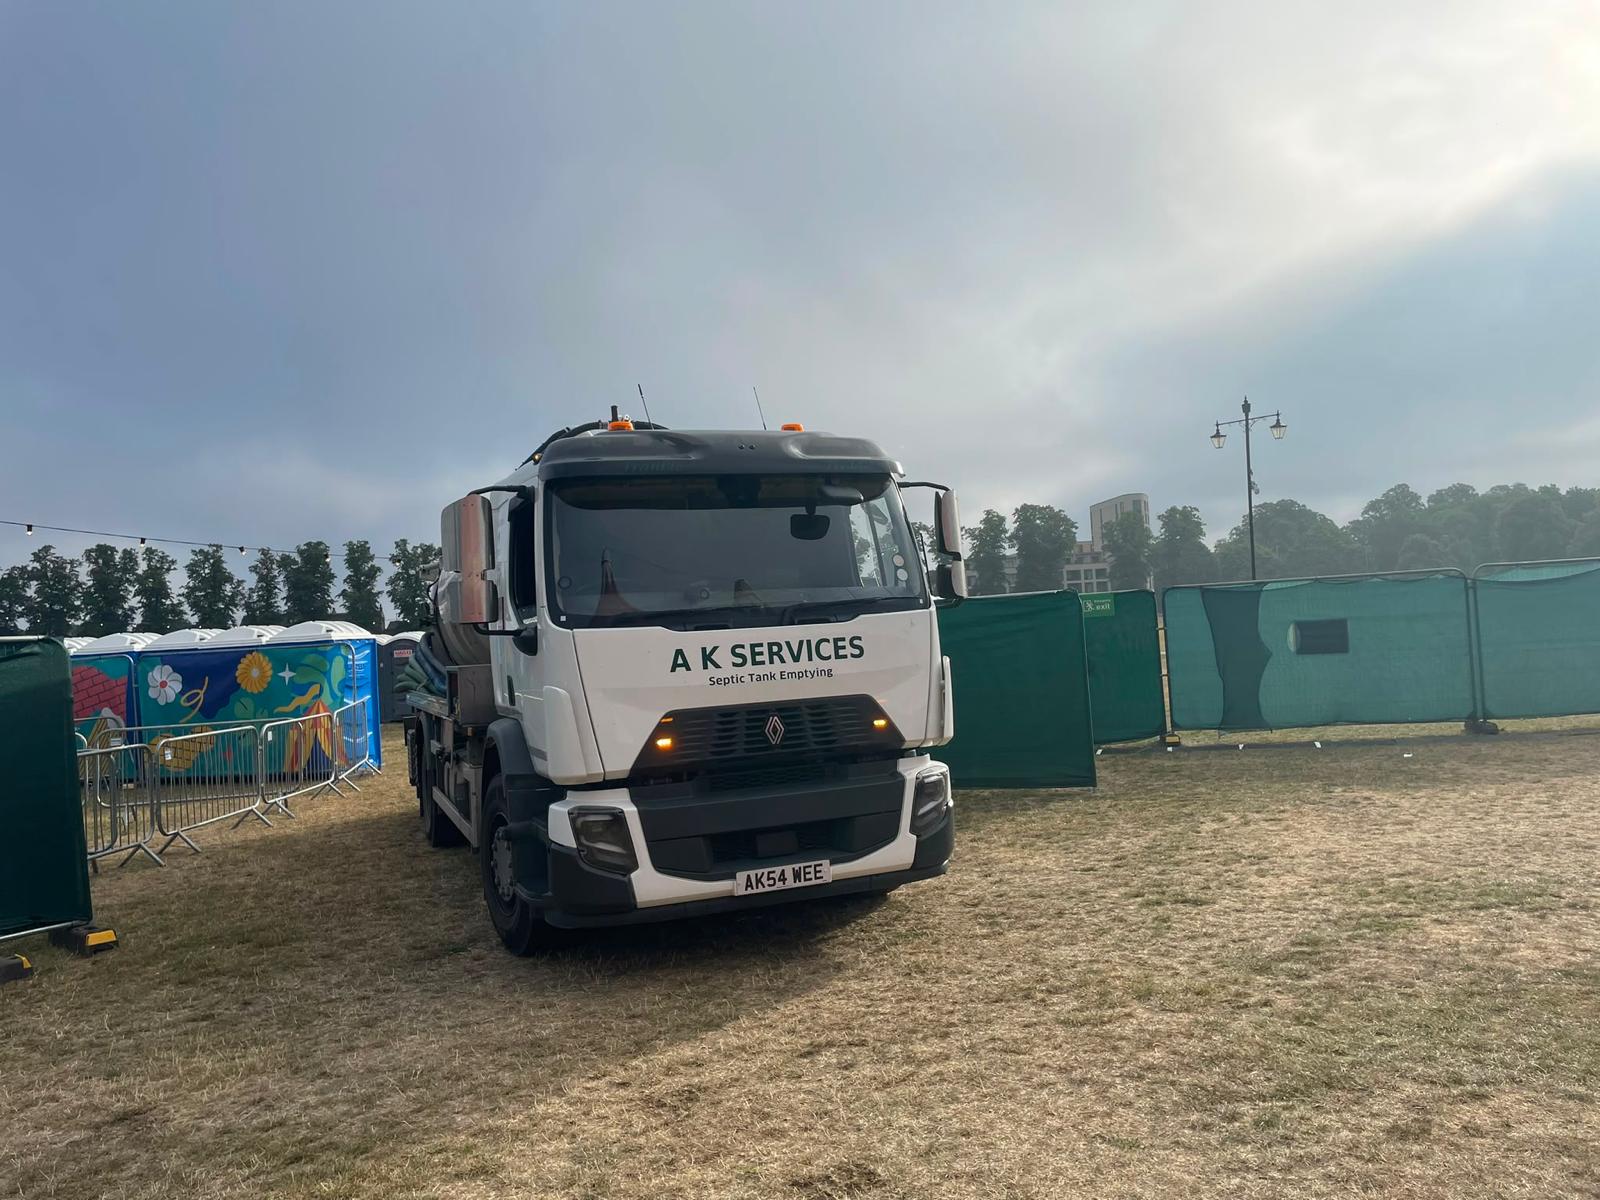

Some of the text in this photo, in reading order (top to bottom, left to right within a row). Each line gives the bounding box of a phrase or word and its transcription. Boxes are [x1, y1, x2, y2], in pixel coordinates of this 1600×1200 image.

[670, 636, 864, 672] A K SERVICES
[709, 668, 833, 686] Septic Tank Emptying
[745, 864, 823, 891] AK54 WEE
